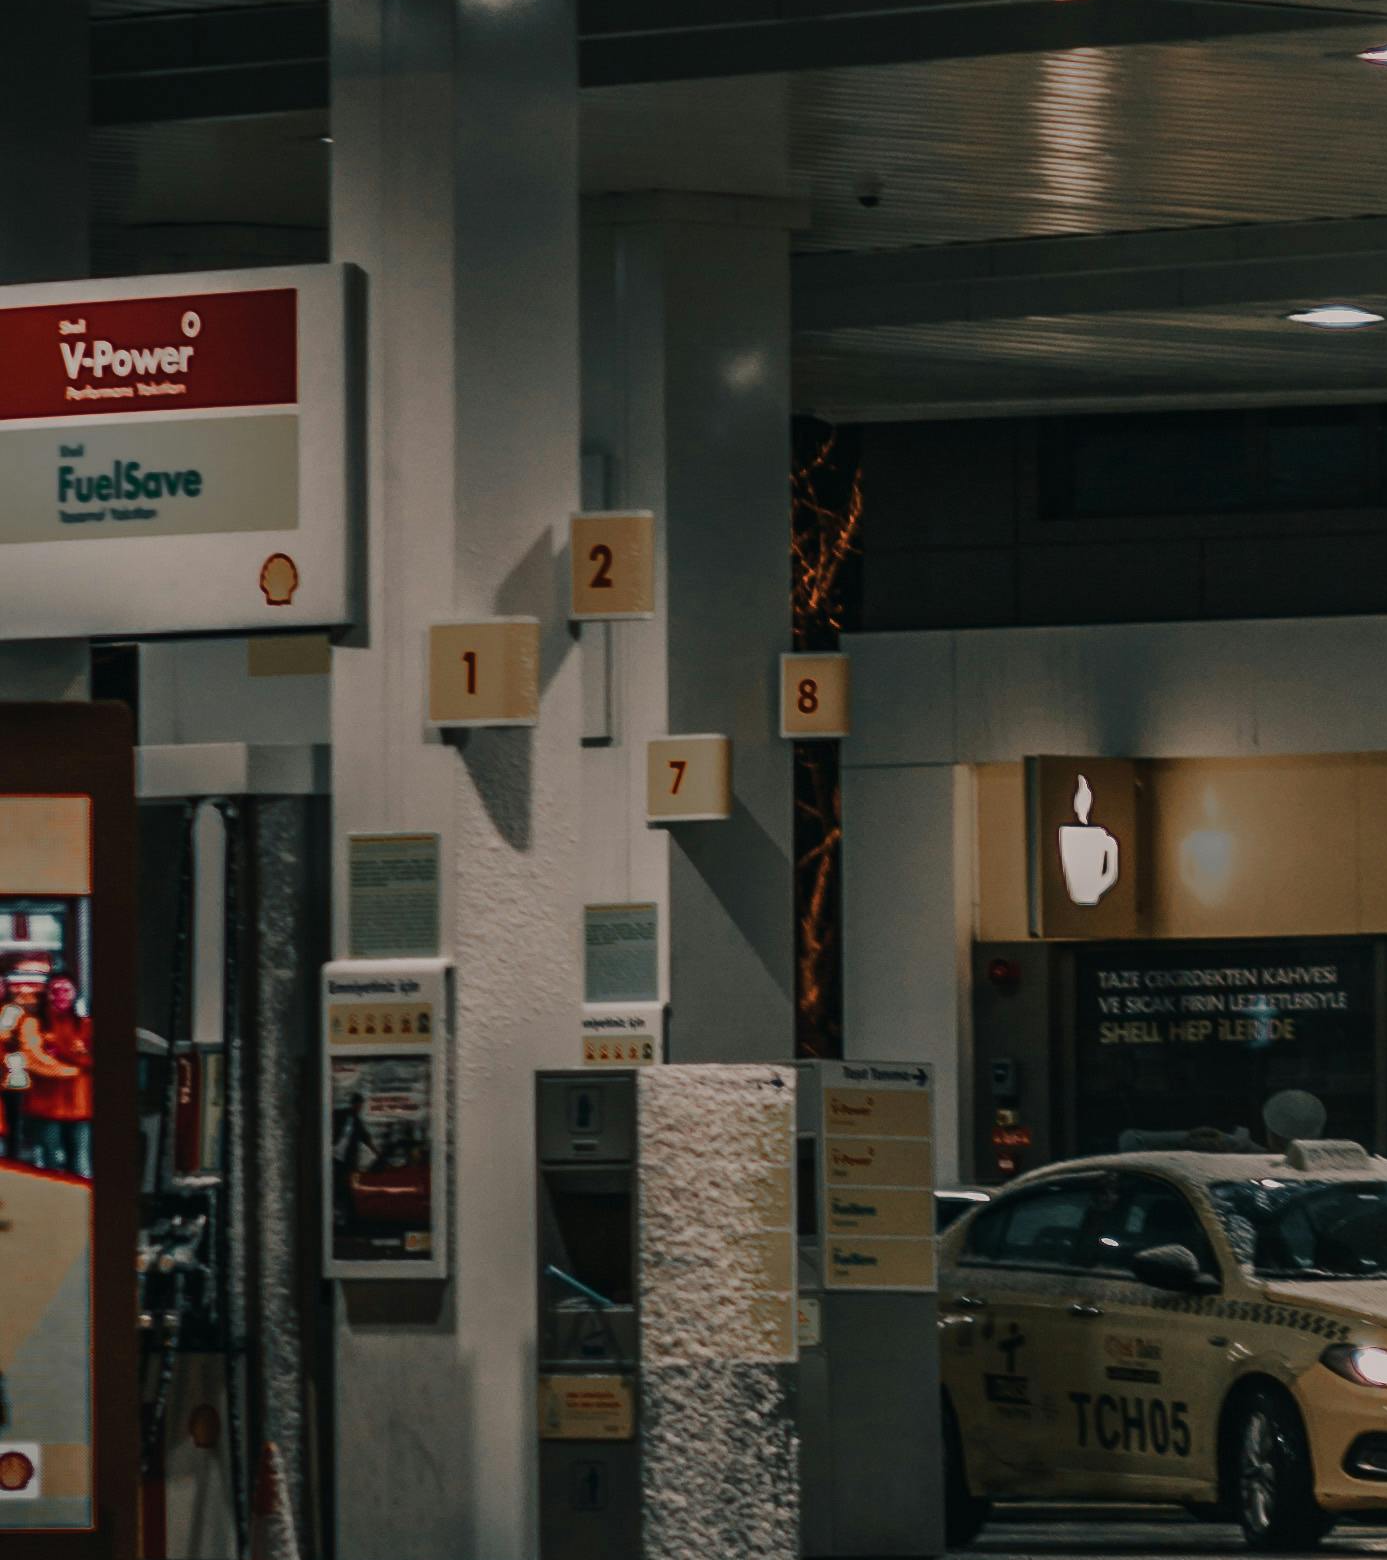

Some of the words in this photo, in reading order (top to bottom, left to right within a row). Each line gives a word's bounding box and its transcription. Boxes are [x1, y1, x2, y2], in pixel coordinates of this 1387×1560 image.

[59, 339, 195, 380] V-Power
[58, 460, 203, 503] FuelSave
[588, 543, 613, 589] 2
[462, 650, 477, 695] 1
[797, 677, 819, 714] 8
[668, 760, 687, 795] 7
[1097, 970, 1141, 989] TAZE
[1260, 964, 1339, 986] KAHVESİ
[1098, 994, 1122, 1014] VE
[1099, 1020, 1163, 1045] SHELL
[1167, 1019, 1214, 1043] HEP
[1068, 1391, 1191, 1458] TCH05
